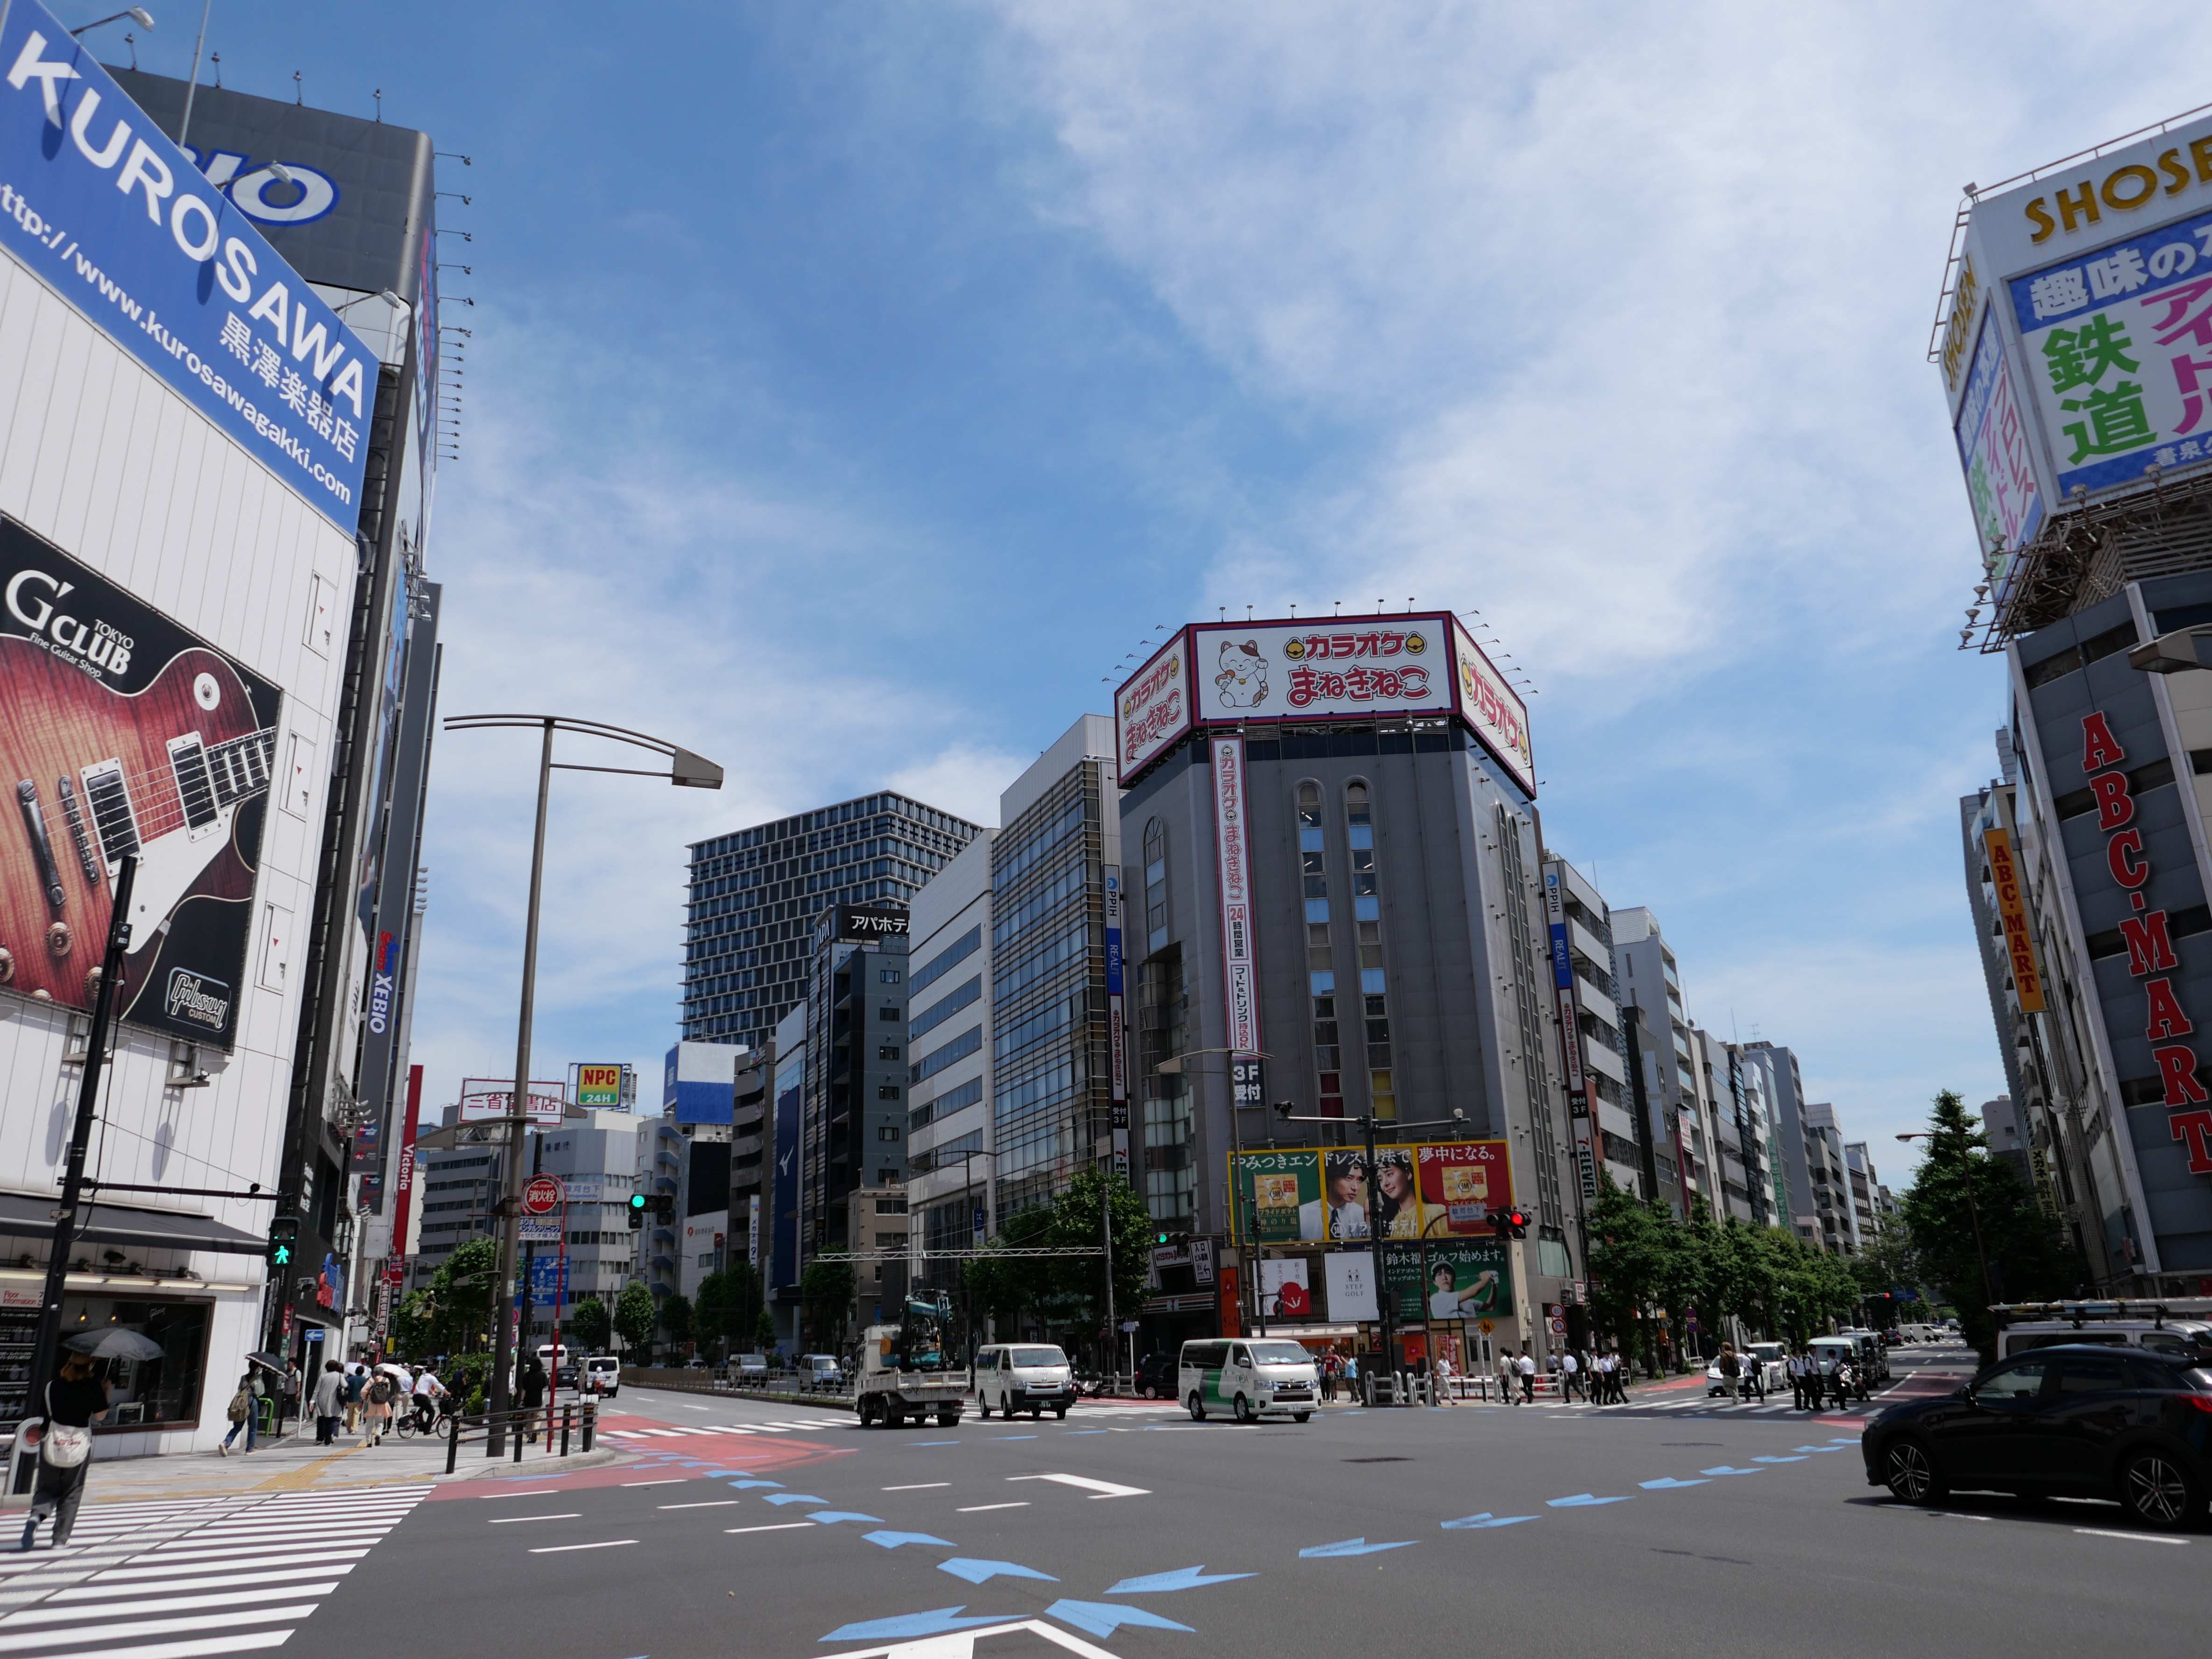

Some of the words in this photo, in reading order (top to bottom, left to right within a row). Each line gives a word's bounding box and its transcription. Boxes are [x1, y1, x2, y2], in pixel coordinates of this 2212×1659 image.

[7, 30, 363, 419] KUROSAWA
[1944, 251, 1980, 392] SHOSEN
[0, 181, 351, 504] ttp://www.kurosawagakki.com
[220, 311, 358, 463] 黒澤楽器店
[2042, 313, 2157, 466] 鉄道
[93, 619, 135, 650] TOKYO
[1305, 631, 1406, 660] カラオケ
[30, 632, 49, 650] Fine
[50, 644, 78, 665] Guitar
[77, 659, 102, 679] Shop
[1130, 659, 1171, 717] カラオケ
[1287, 664, 1432, 708] まねきねこ
[1469, 661, 1519, 752] カラオケ
[1125, 688, 1182, 764] まねきねこ
[1220, 757, 1238, 810] カラオケ
[1224, 822, 1243, 900] まねきねこ
[1109, 891, 1117, 916] PPIH
[1549, 888, 1559, 913] PPIH
[817, 919, 830, 947] APA
[1230, 907, 1244, 957] 24時間営業
[170, 973, 227, 1028] Gibson
[188, 1008, 217, 1024] CUSTOM
[370, 971, 393, 1034] XEBIO
[1564, 1009, 1573, 1035] カラオケ
[1234, 1065, 1259, 1081] 3F
[1568, 1041, 1579, 1077] まねきねこ
[583, 1069, 616, 1085] NPC
[1234, 1085, 1261, 1101] 受付
[468, 1093, 557, 1111] 三省書店
[586, 1094, 611, 1103] 24H
[399, 1143, 414, 1191] Victoria
[1418, 1145, 1495, 1163] 夢中になる。
[528, 1190, 556, 1203] 消火栓
[1452, 1205, 1481, 1214] 駿河台下
[1348, 1220, 1417, 1233] プラポテト
[1195, 1243, 1205, 1252] 入口
